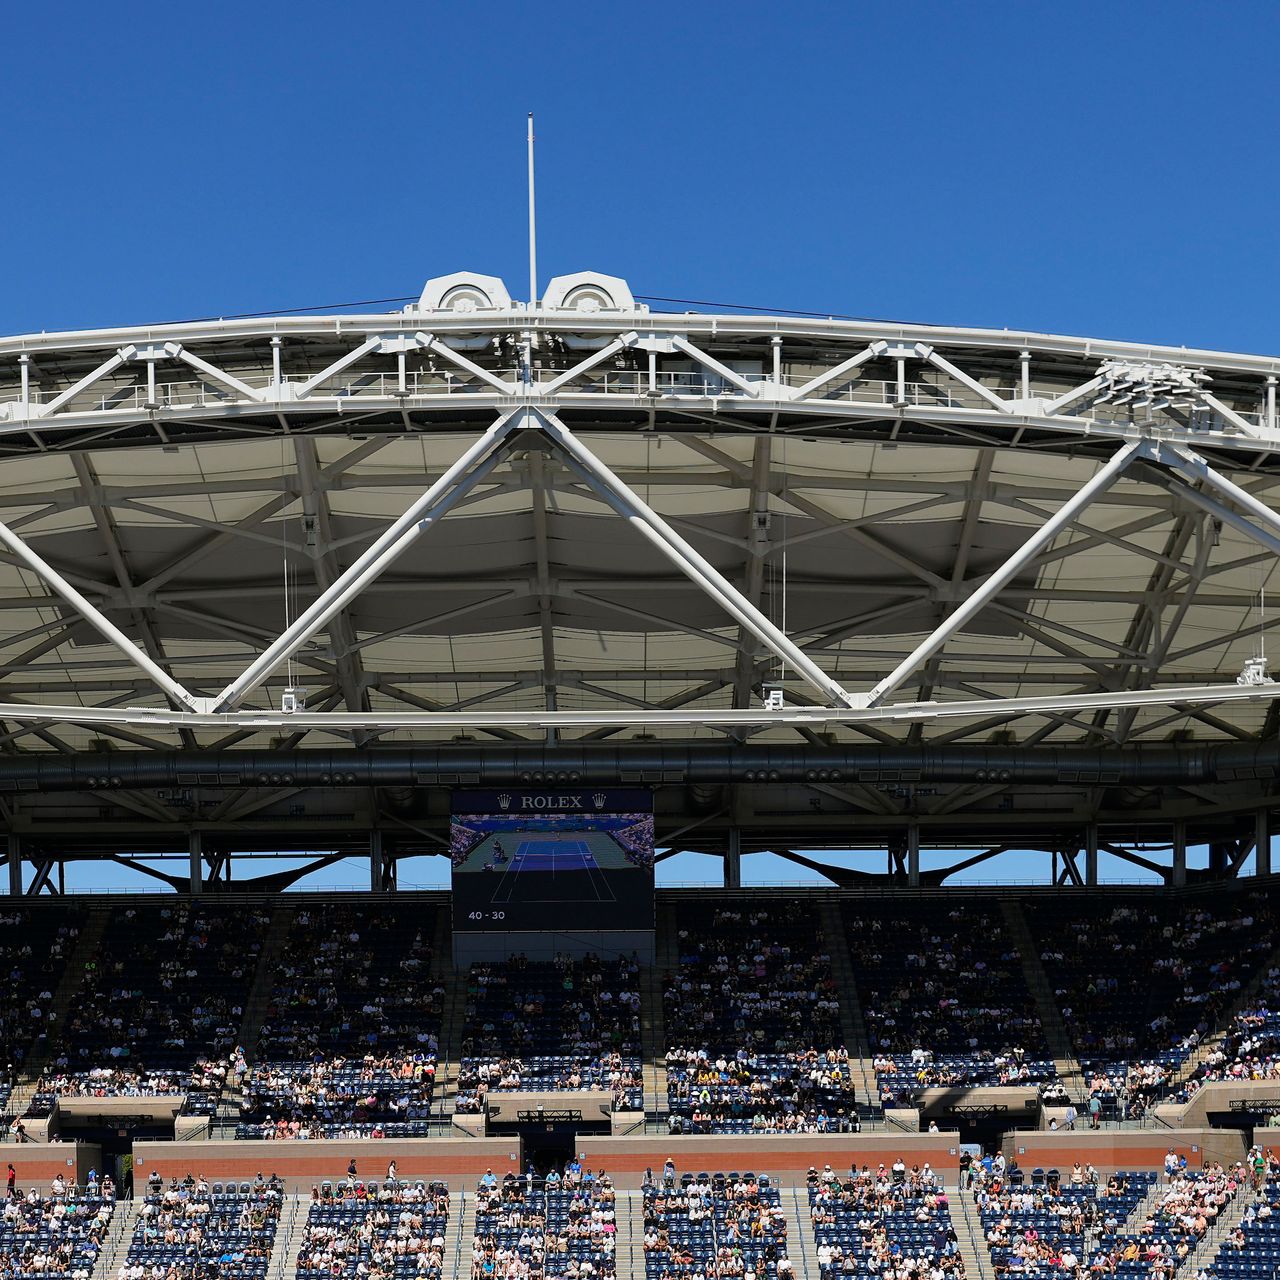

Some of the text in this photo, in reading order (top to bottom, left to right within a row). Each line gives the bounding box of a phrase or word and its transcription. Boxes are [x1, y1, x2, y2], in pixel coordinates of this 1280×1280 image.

[520, 795, 584, 809] ROLEX
[468, 911, 483, 920] 40
[492, 911, 505, 920] 30
